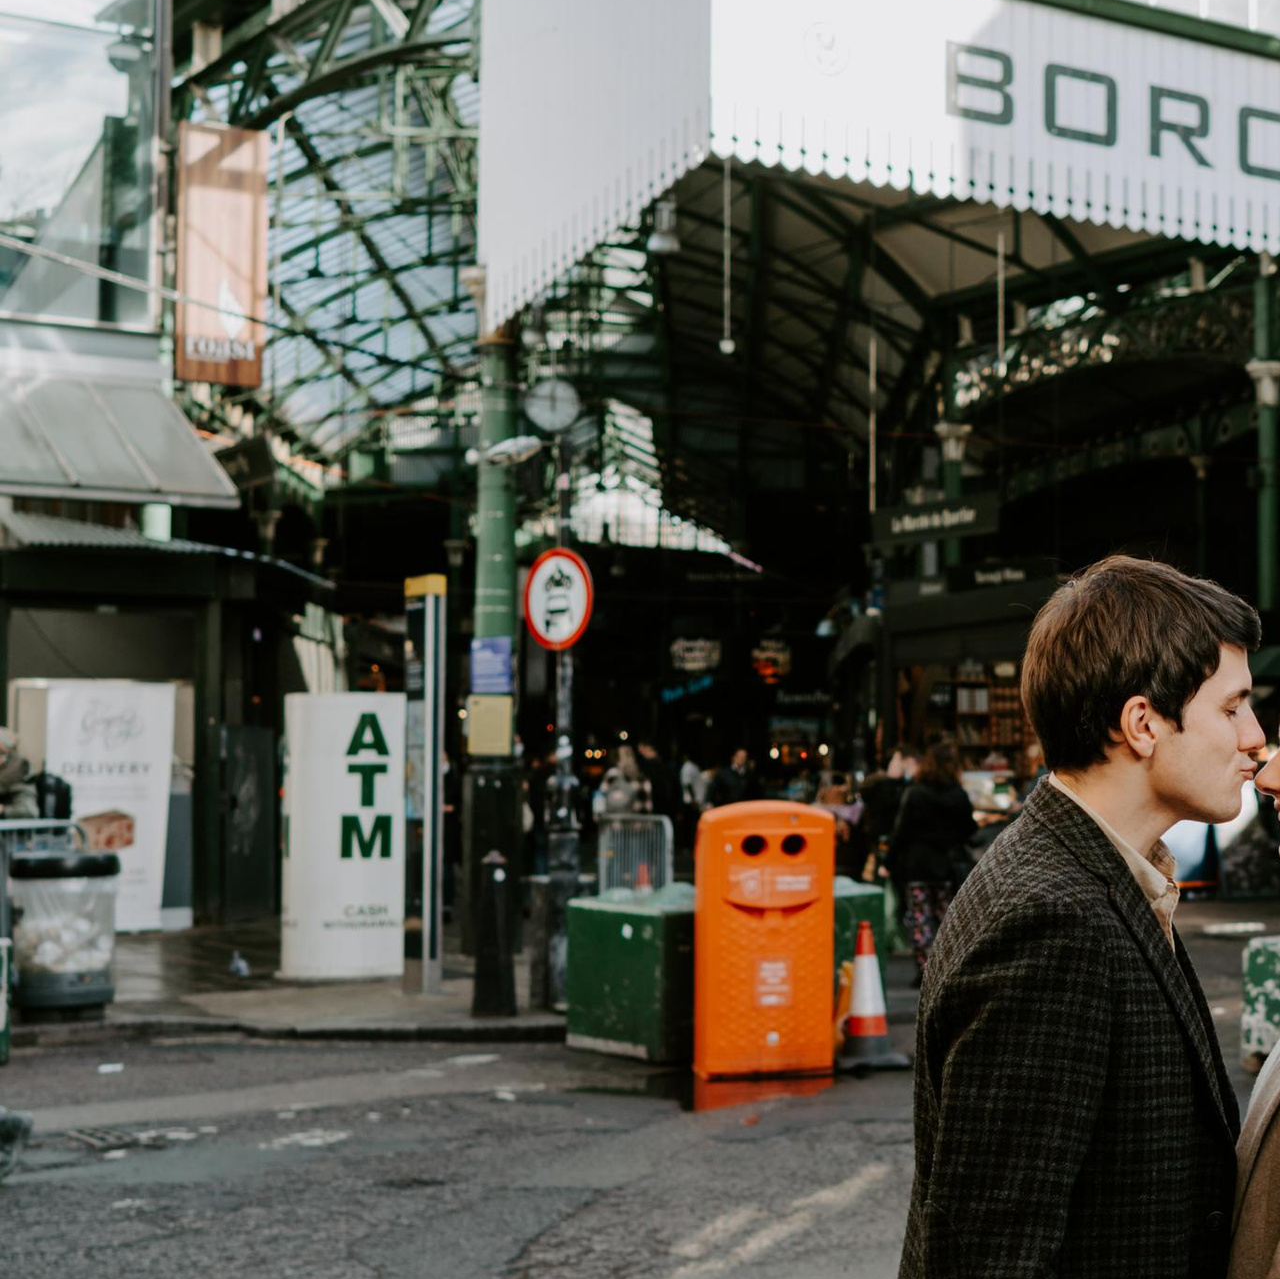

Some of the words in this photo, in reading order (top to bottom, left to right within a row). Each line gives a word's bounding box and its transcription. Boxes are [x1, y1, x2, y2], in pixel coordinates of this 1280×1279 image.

[62, 760, 152, 776] DELIVERY
[341, 713, 392, 858] ATM
[344, 904, 388, 918] CASH
